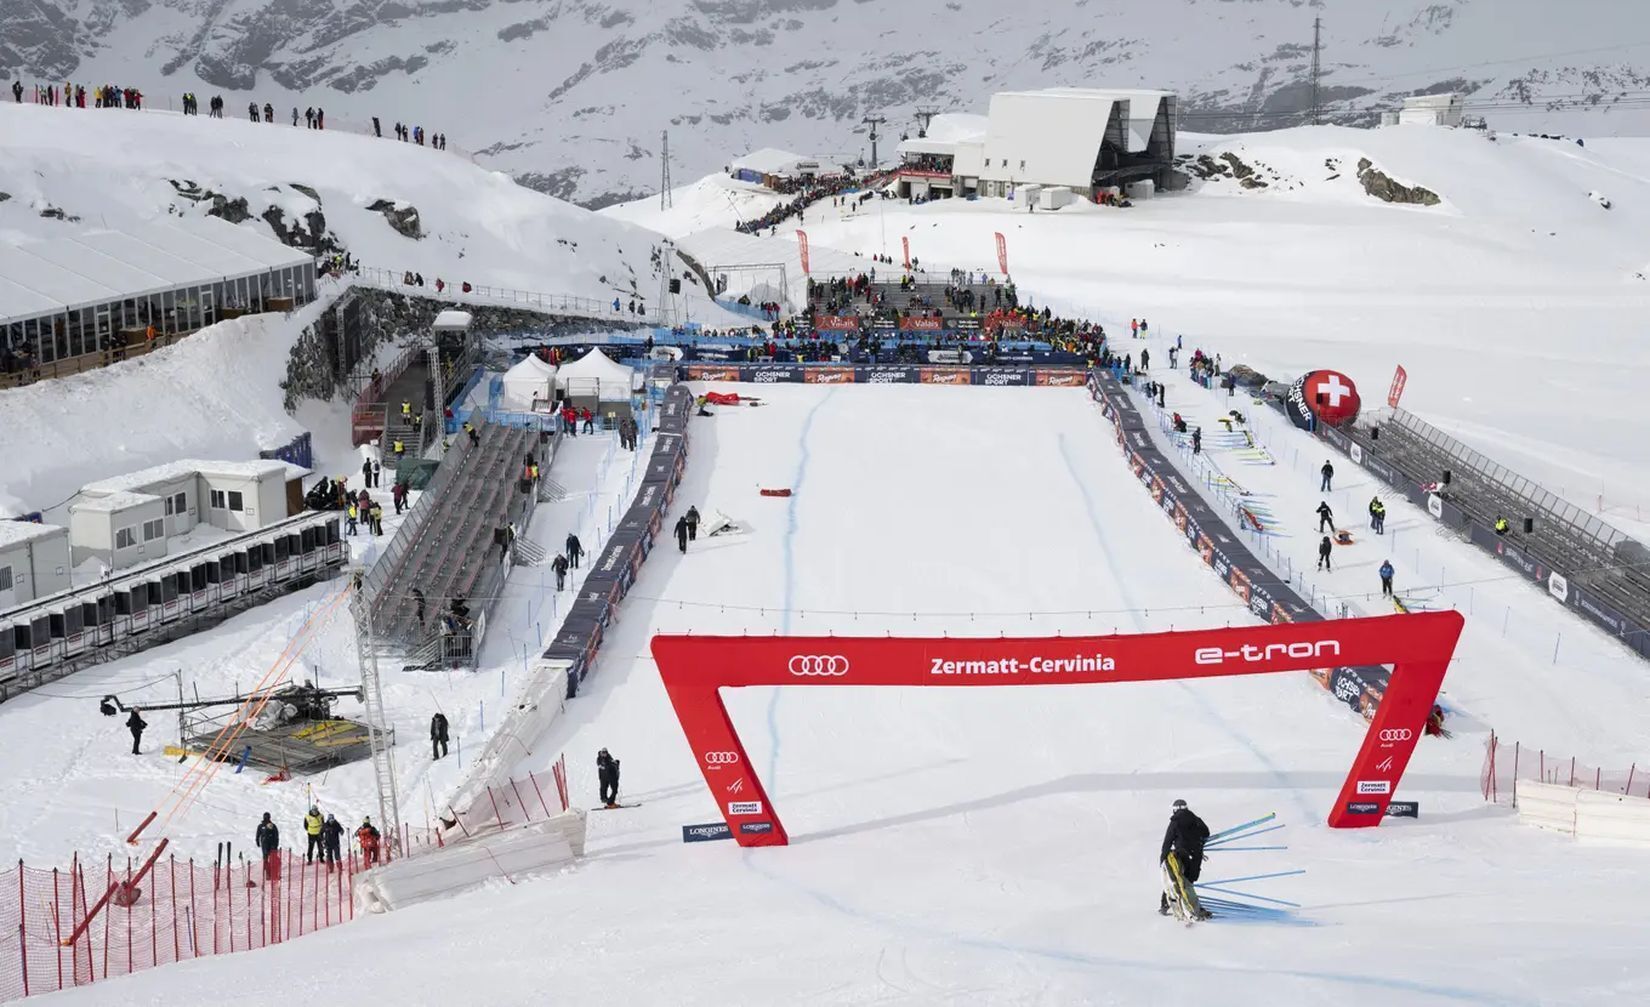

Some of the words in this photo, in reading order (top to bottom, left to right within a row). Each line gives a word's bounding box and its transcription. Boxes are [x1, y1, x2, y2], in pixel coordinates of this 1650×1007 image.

[1194, 639, 1341, 665] e-tron
[930, 653, 1116, 675] Zermatt-Cervinia
[689, 826, 729, 834] LONGINES
